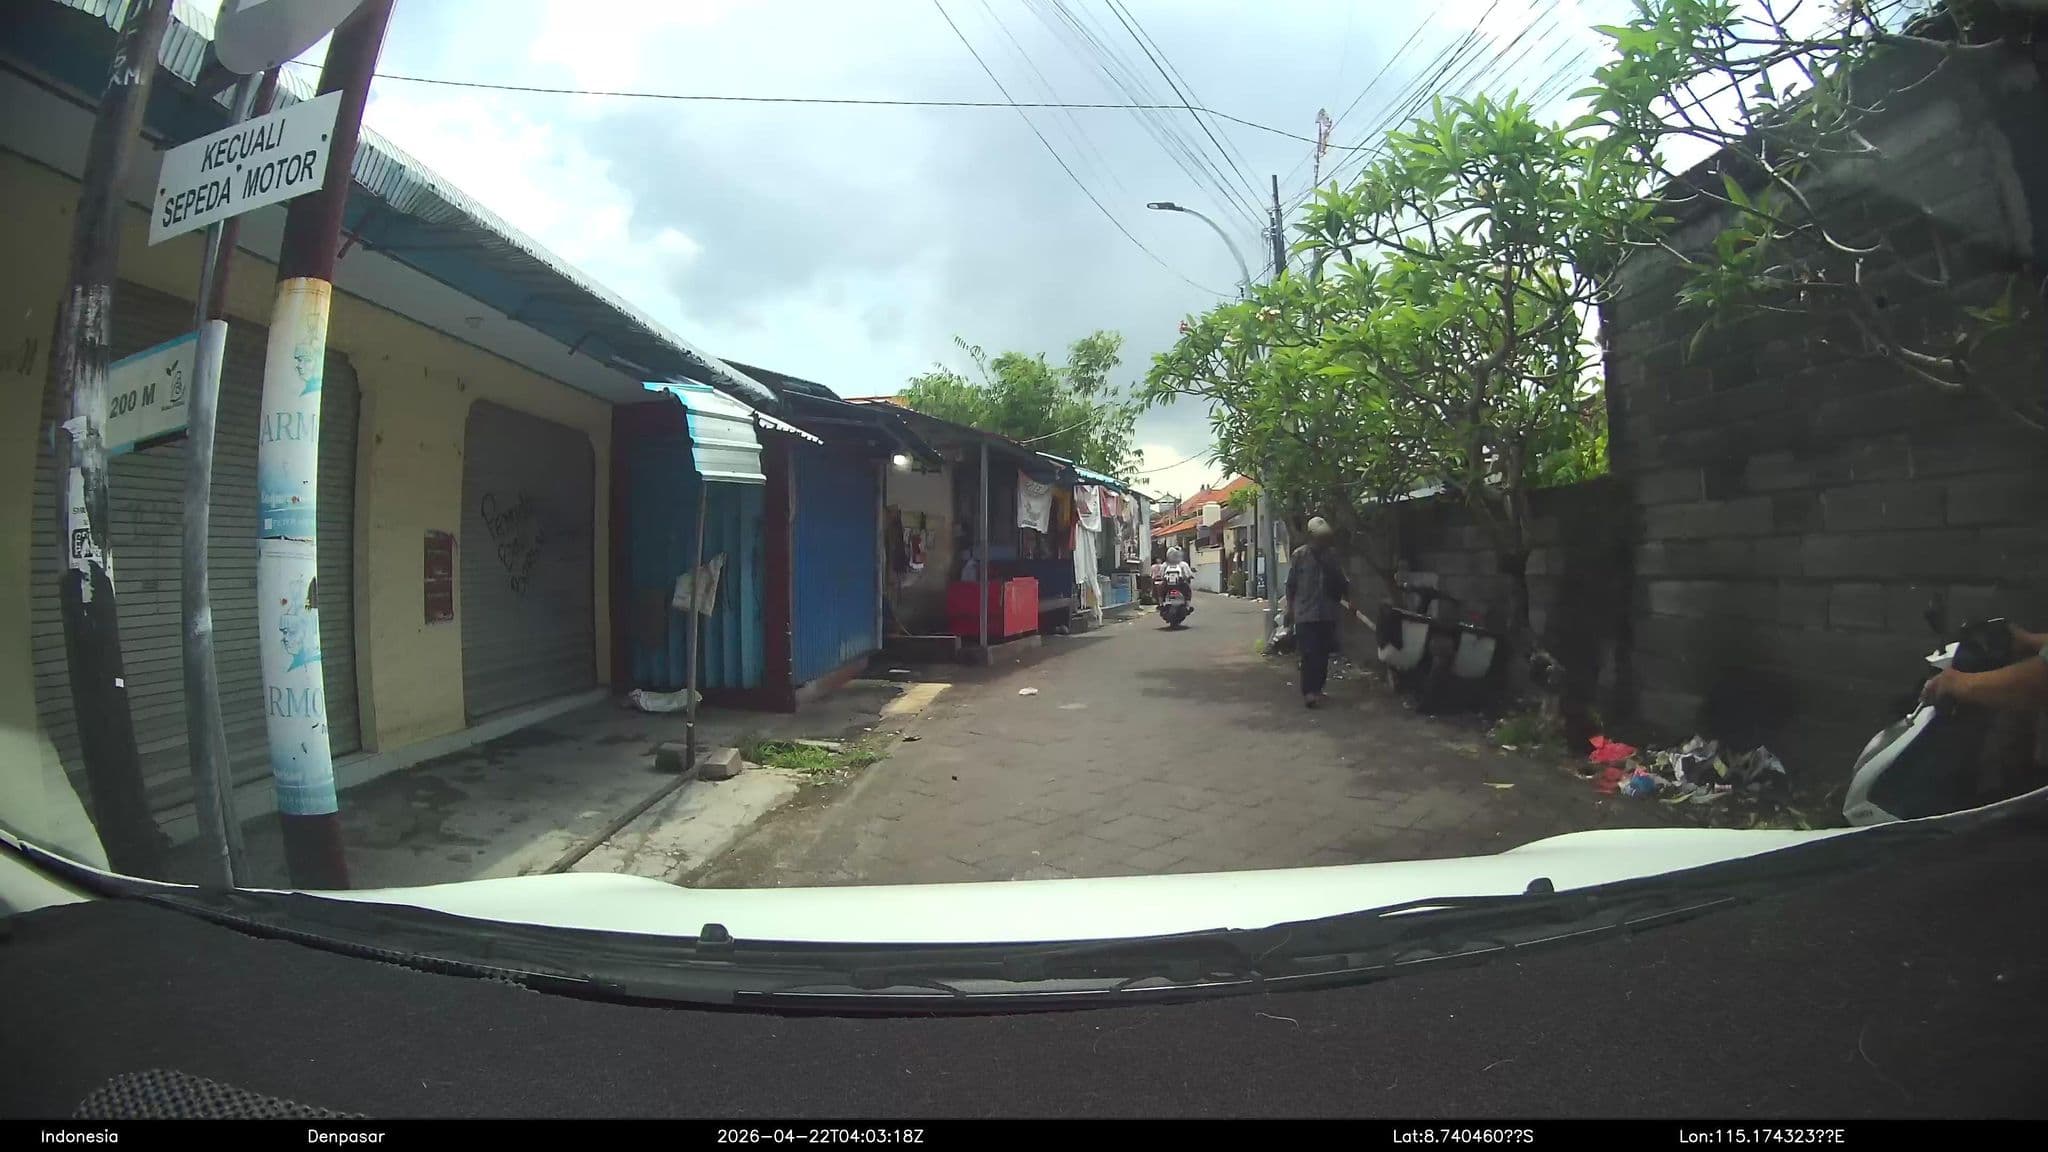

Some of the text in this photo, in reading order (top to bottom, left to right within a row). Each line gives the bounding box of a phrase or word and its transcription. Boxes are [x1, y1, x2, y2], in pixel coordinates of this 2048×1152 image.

[201, 117, 286, 173] KECUALI
[161, 149, 318, 229] SEPEDA MOTOR
[108, 389, 138, 419] 200
[142, 382, 157, 408] M
